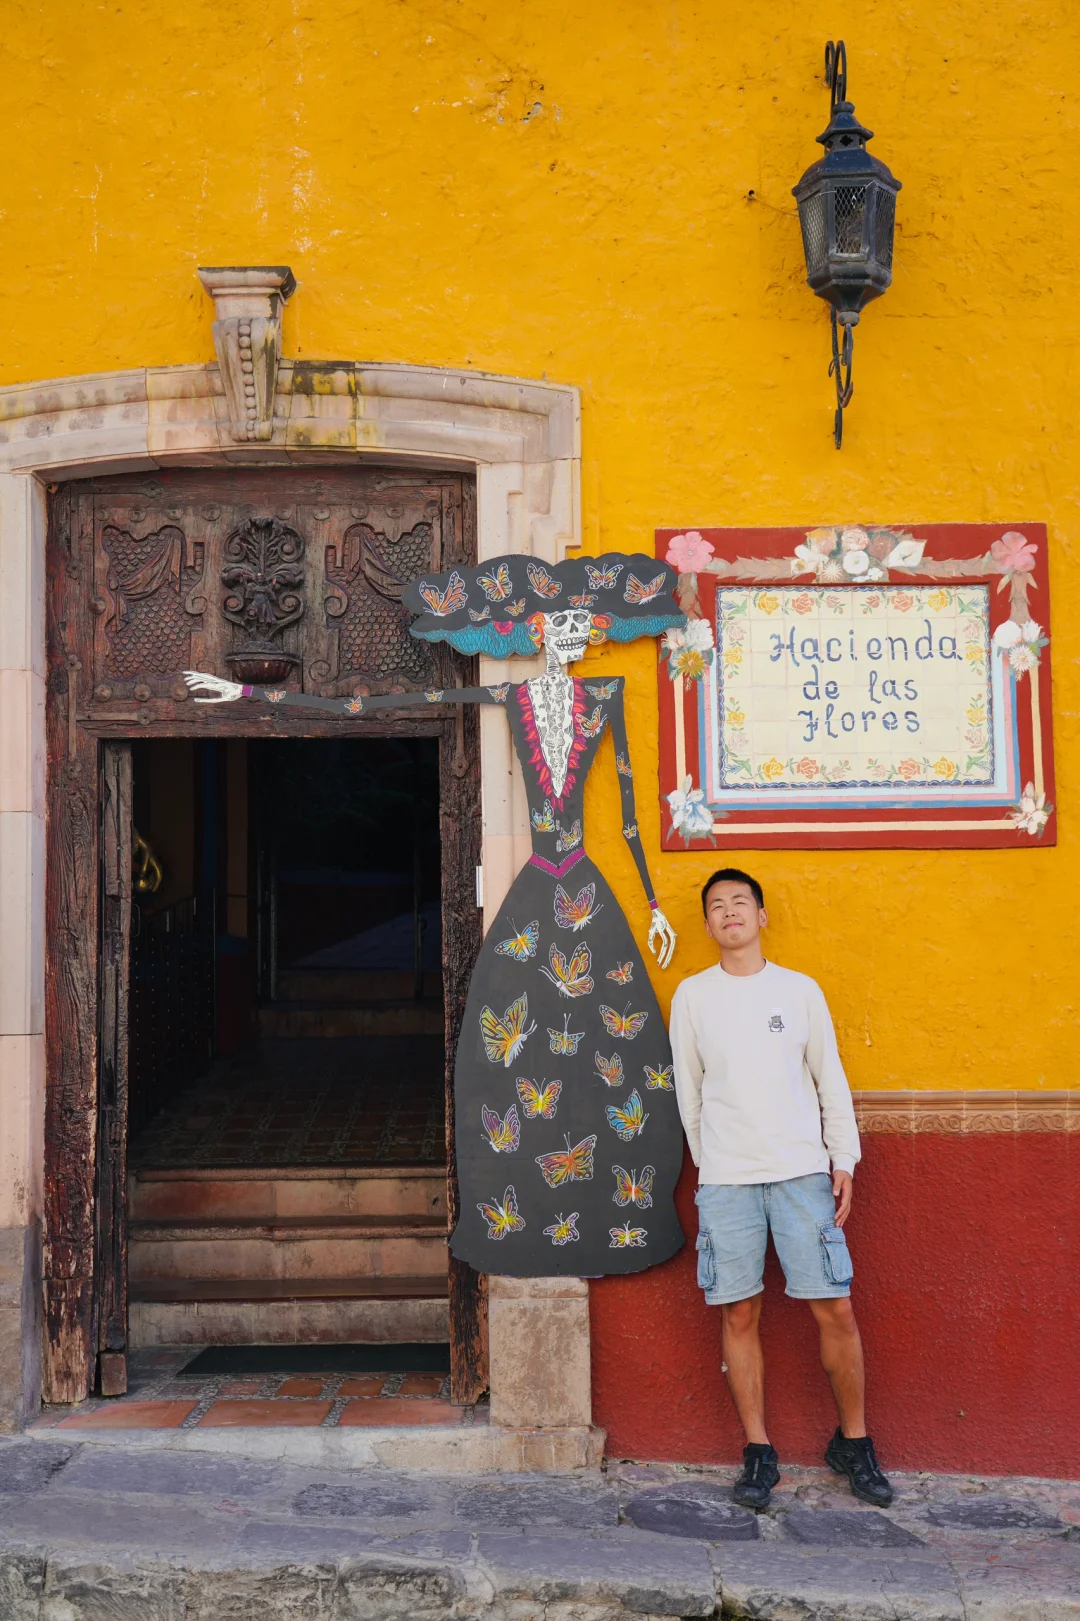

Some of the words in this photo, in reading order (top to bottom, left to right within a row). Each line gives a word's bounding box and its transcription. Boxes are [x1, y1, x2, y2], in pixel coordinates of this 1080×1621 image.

[769, 619, 963, 667] Hacienda
[802, 664, 840, 700] de
[868, 670, 919, 704] las
[797, 703, 920, 742] Flores
